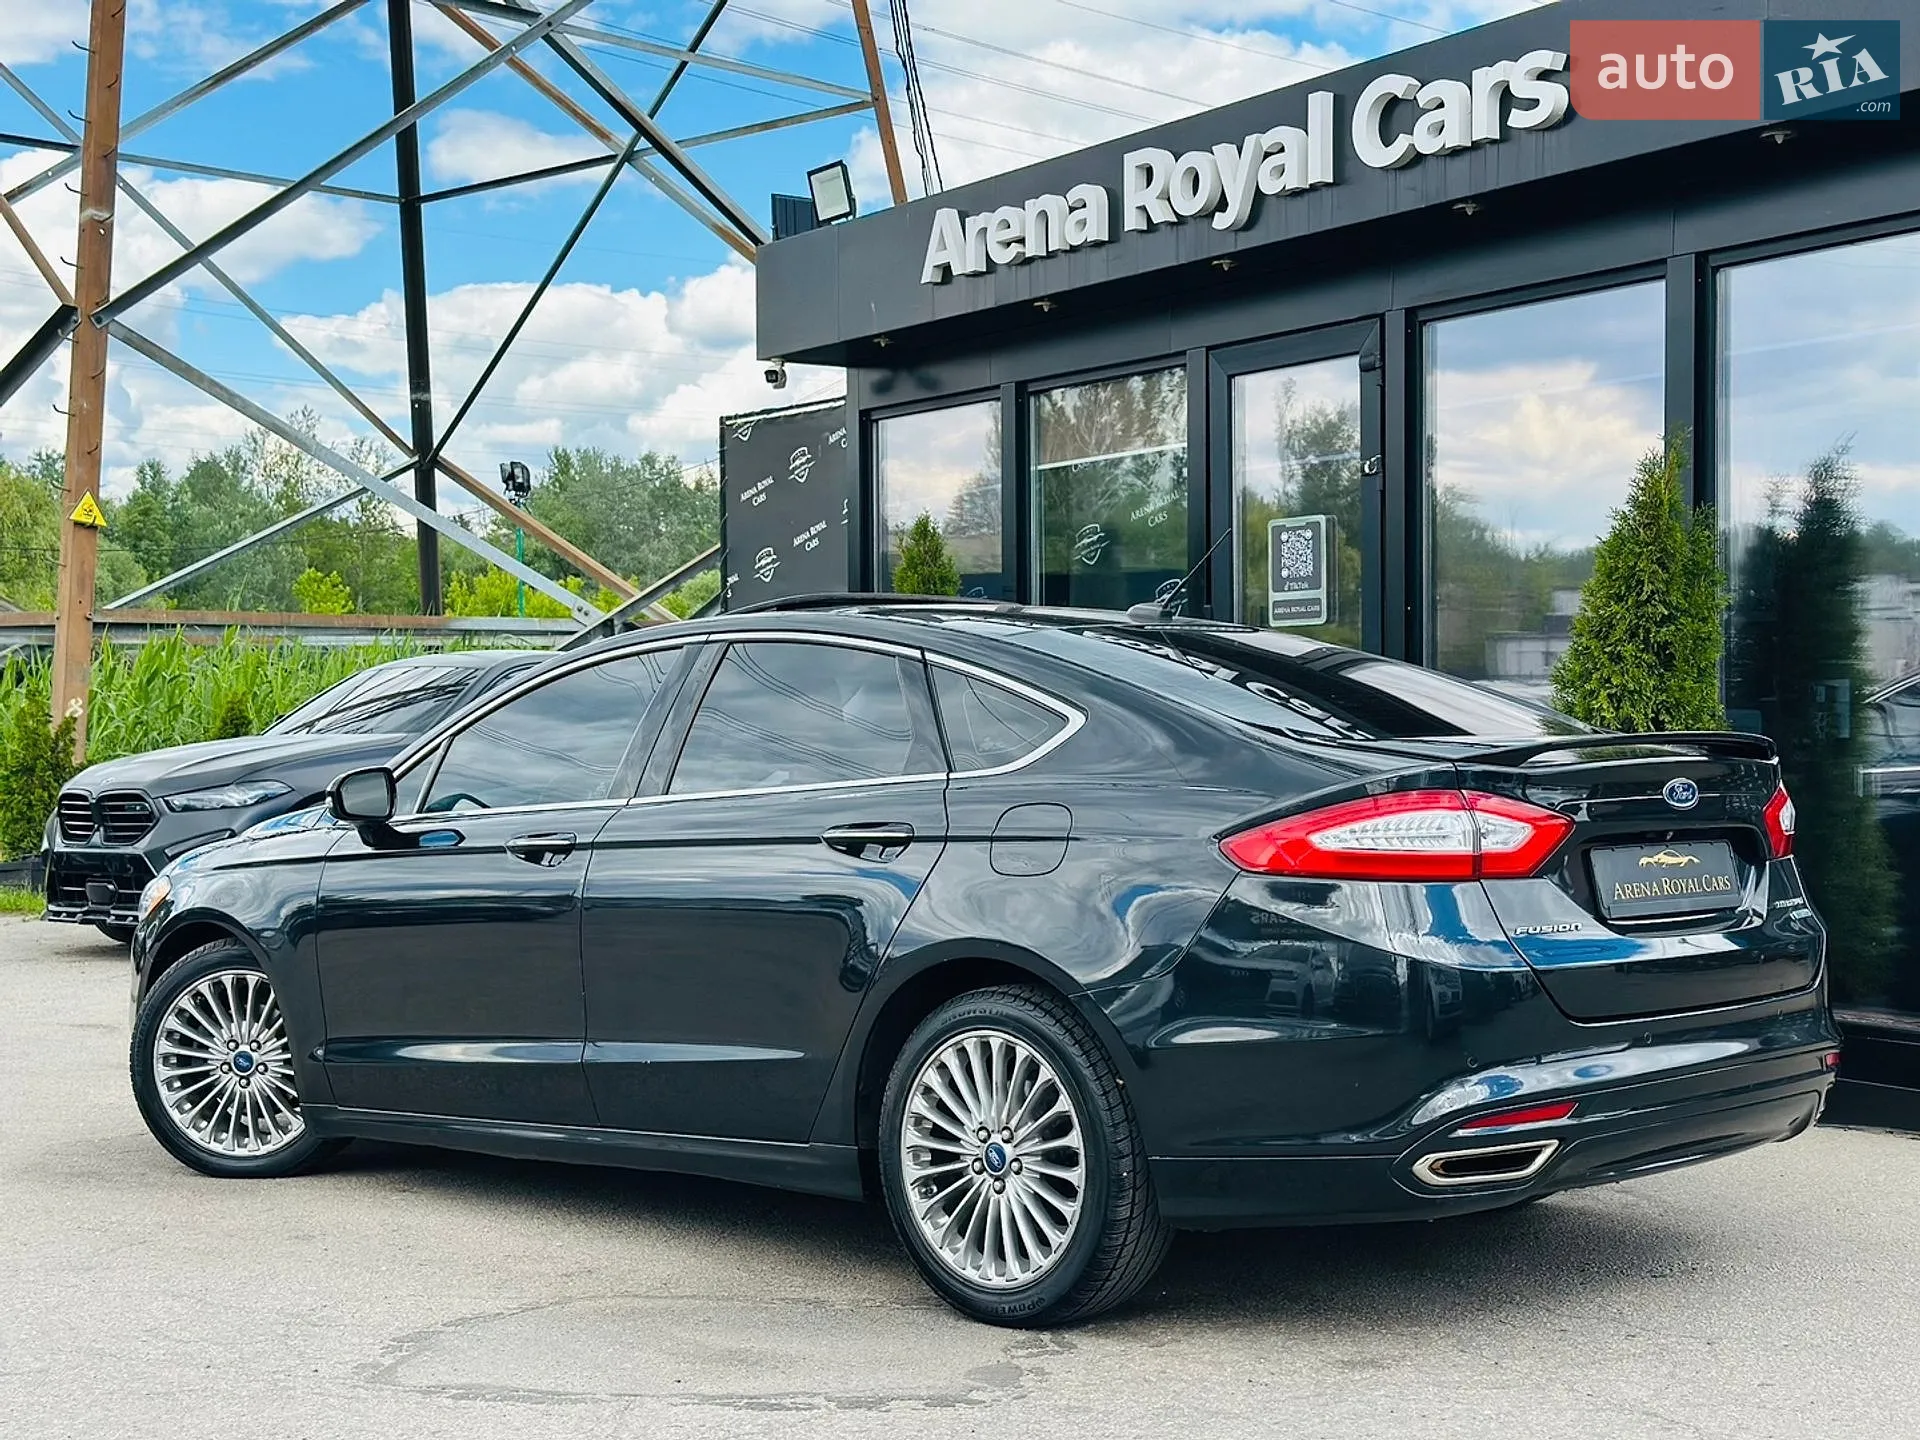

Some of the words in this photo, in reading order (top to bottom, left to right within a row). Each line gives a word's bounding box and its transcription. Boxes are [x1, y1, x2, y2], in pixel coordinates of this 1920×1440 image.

[920, 183, 1110, 285] Arena
[1123, 91, 1335, 231] Royal
[1351, 49, 1570, 169] Cars
[1614, 881, 1660, 900] ARENA
[1660, 876, 1702, 895] ROYAL
[1702, 874, 1731, 892] CARS
[1514, 922, 1583, 936] FUSION
